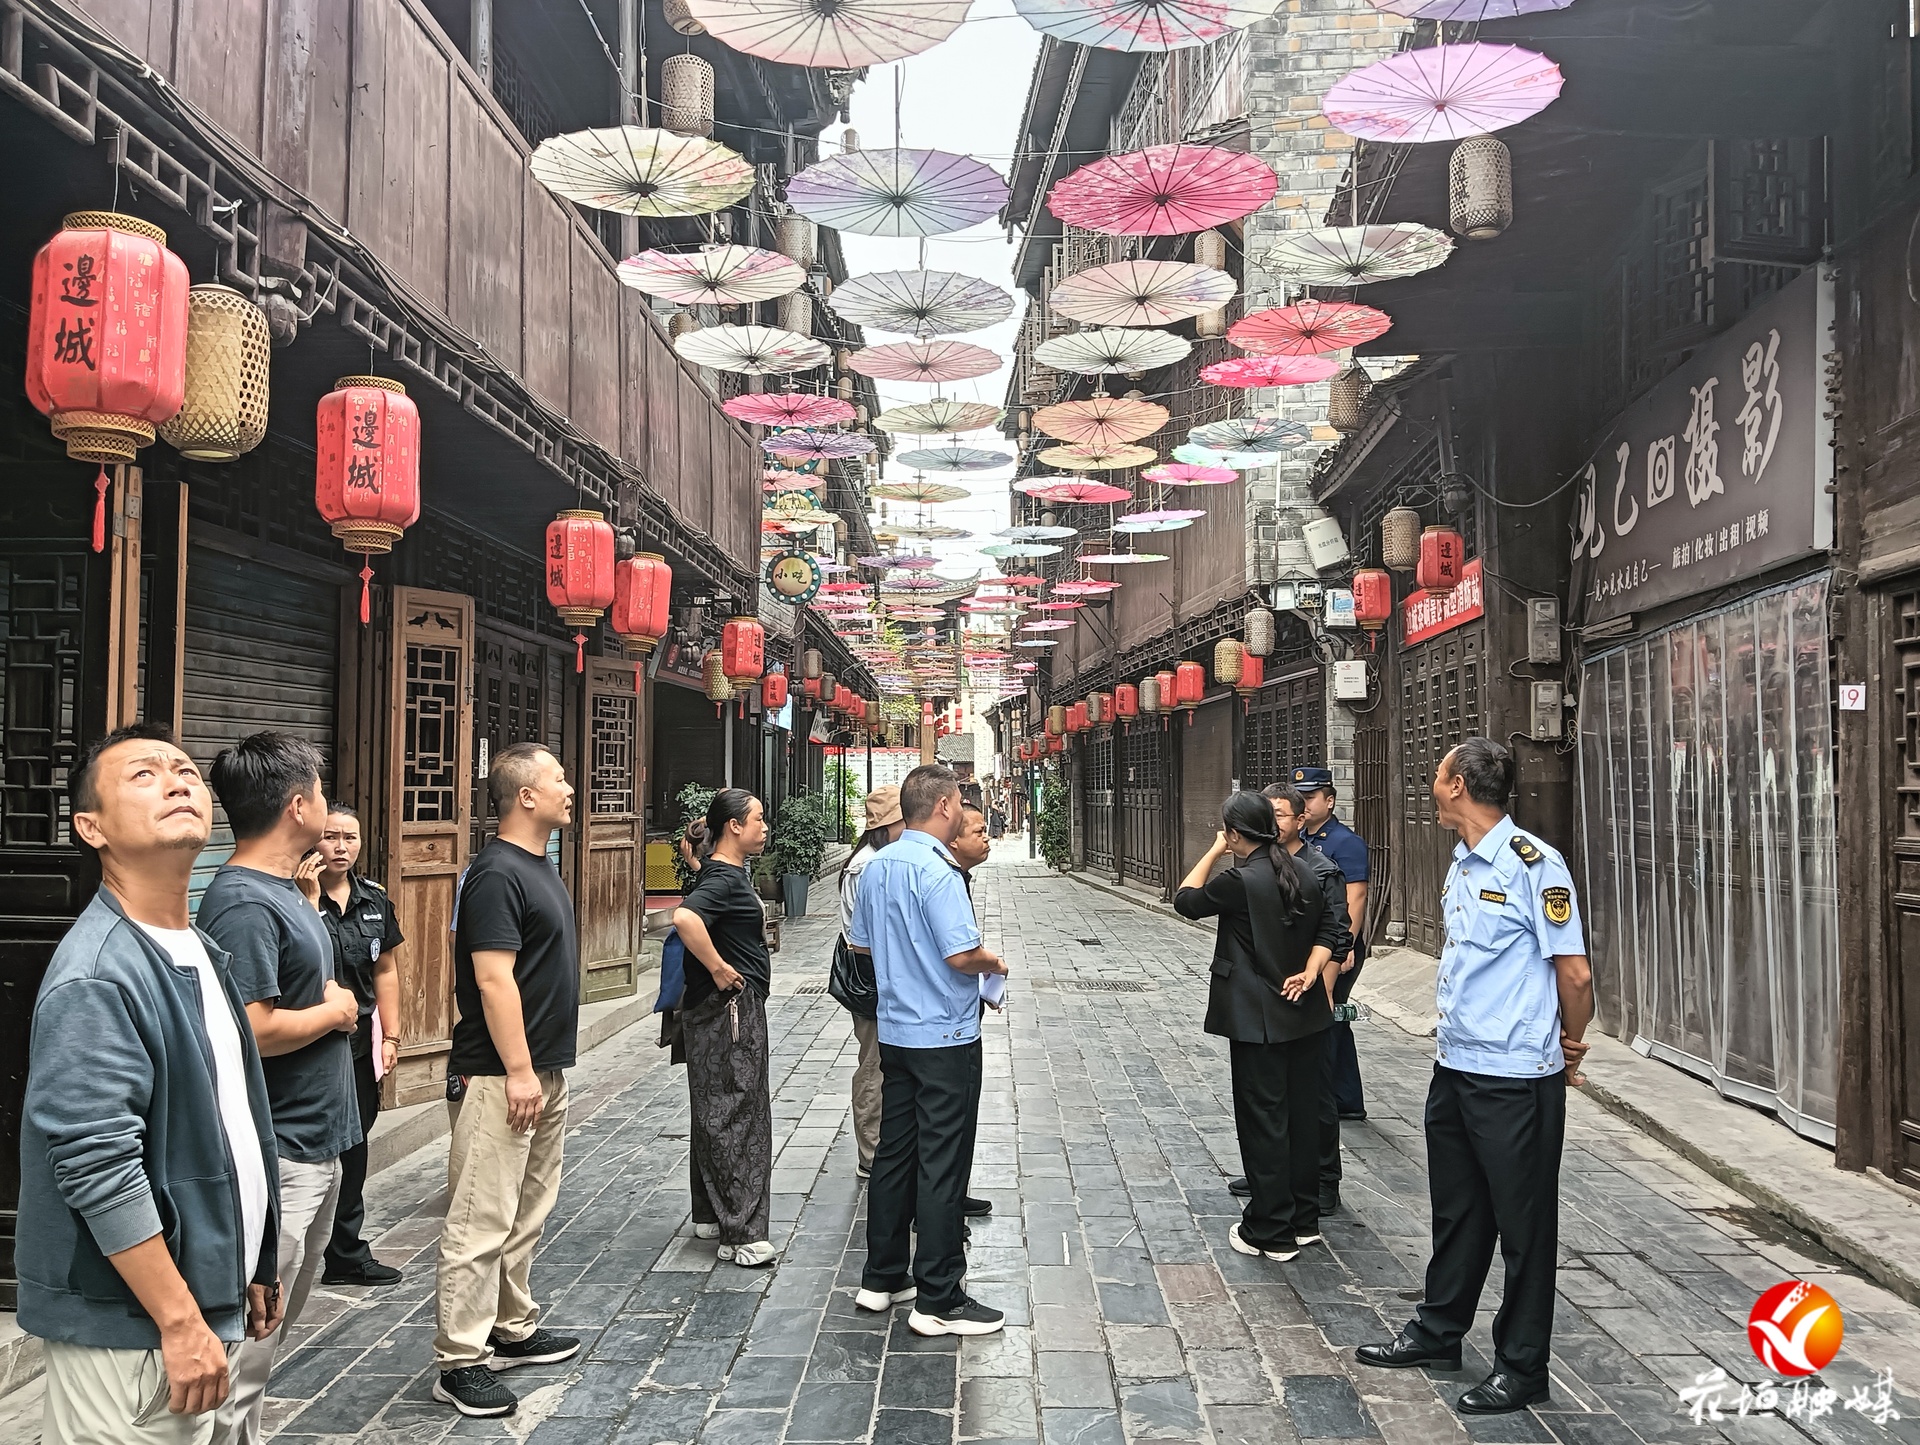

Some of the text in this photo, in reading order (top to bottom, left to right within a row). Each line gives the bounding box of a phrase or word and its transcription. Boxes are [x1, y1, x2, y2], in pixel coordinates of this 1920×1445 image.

[54, 254, 100, 371] 邊城
[348, 411, 381, 494] 邊城
[550, 534, 565, 589] 邊城
[1440, 542, 1453, 578] 邊城
[1841, 688, 1860, 708] 19
